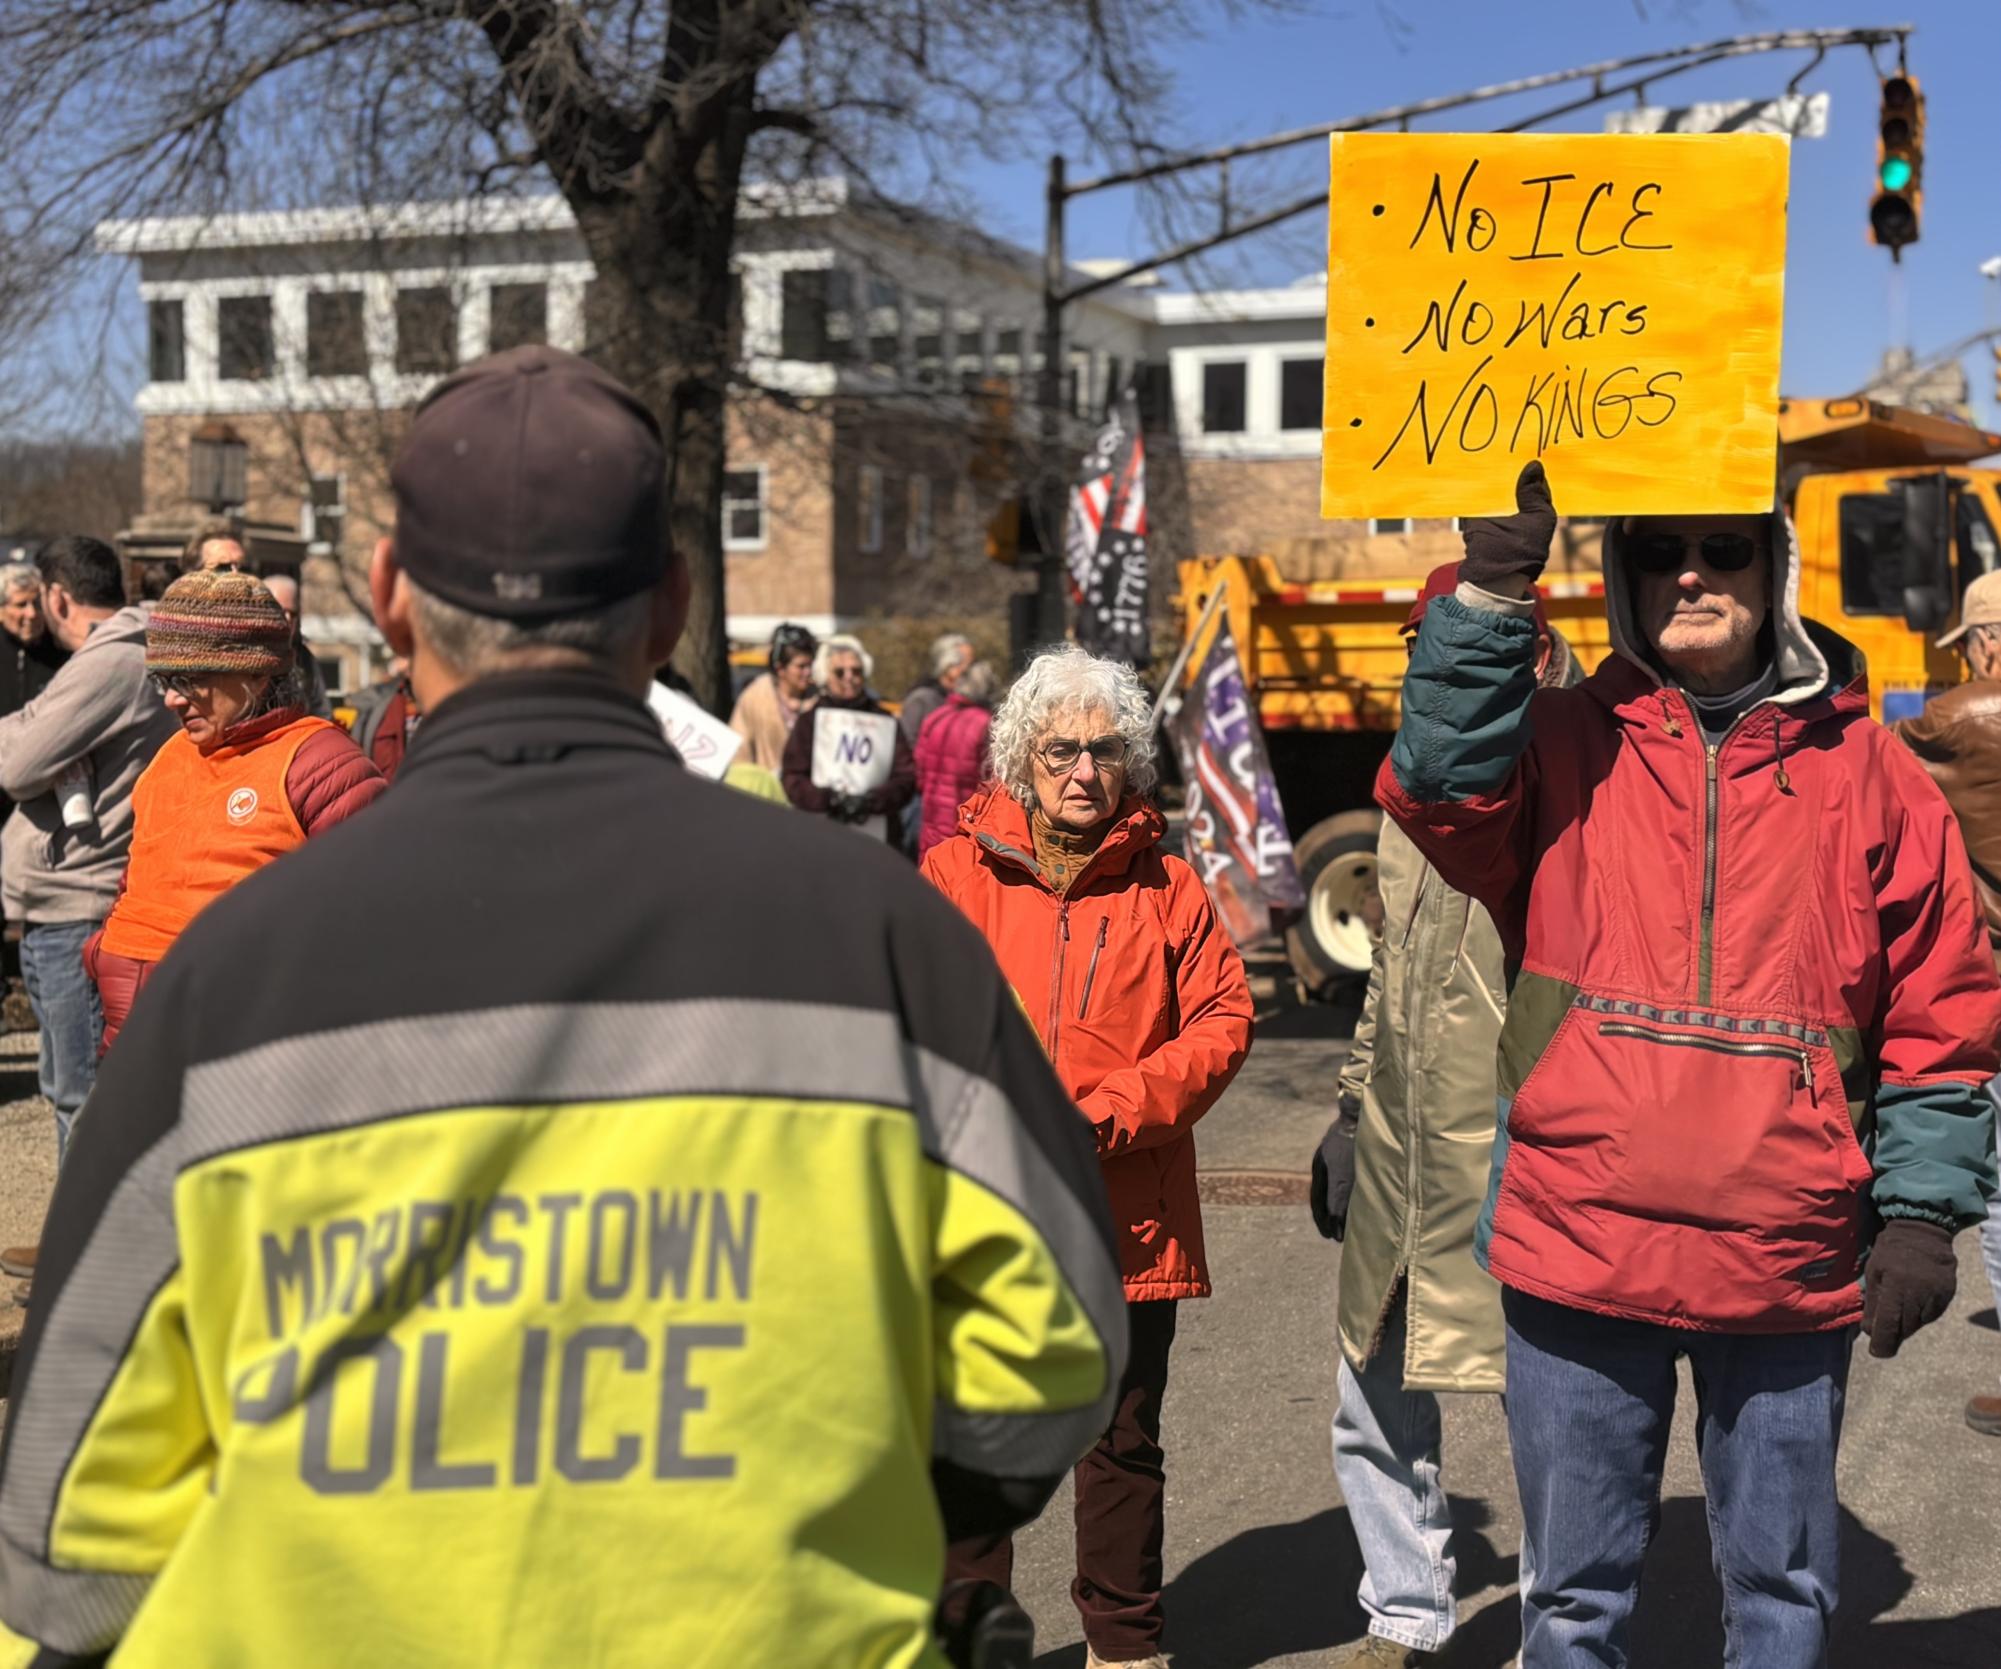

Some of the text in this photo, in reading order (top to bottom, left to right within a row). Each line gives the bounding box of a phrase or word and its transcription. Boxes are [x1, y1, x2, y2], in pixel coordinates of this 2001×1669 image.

[1410, 158, 1673, 261] No ICE
[1503, 272, 1648, 349] Wars
[1372, 355, 1499, 471] NO
[1112, 553, 1148, 619] 1776
[834, 733, 873, 764] NO
[261, 1189, 759, 1340] MORRISTOWN
